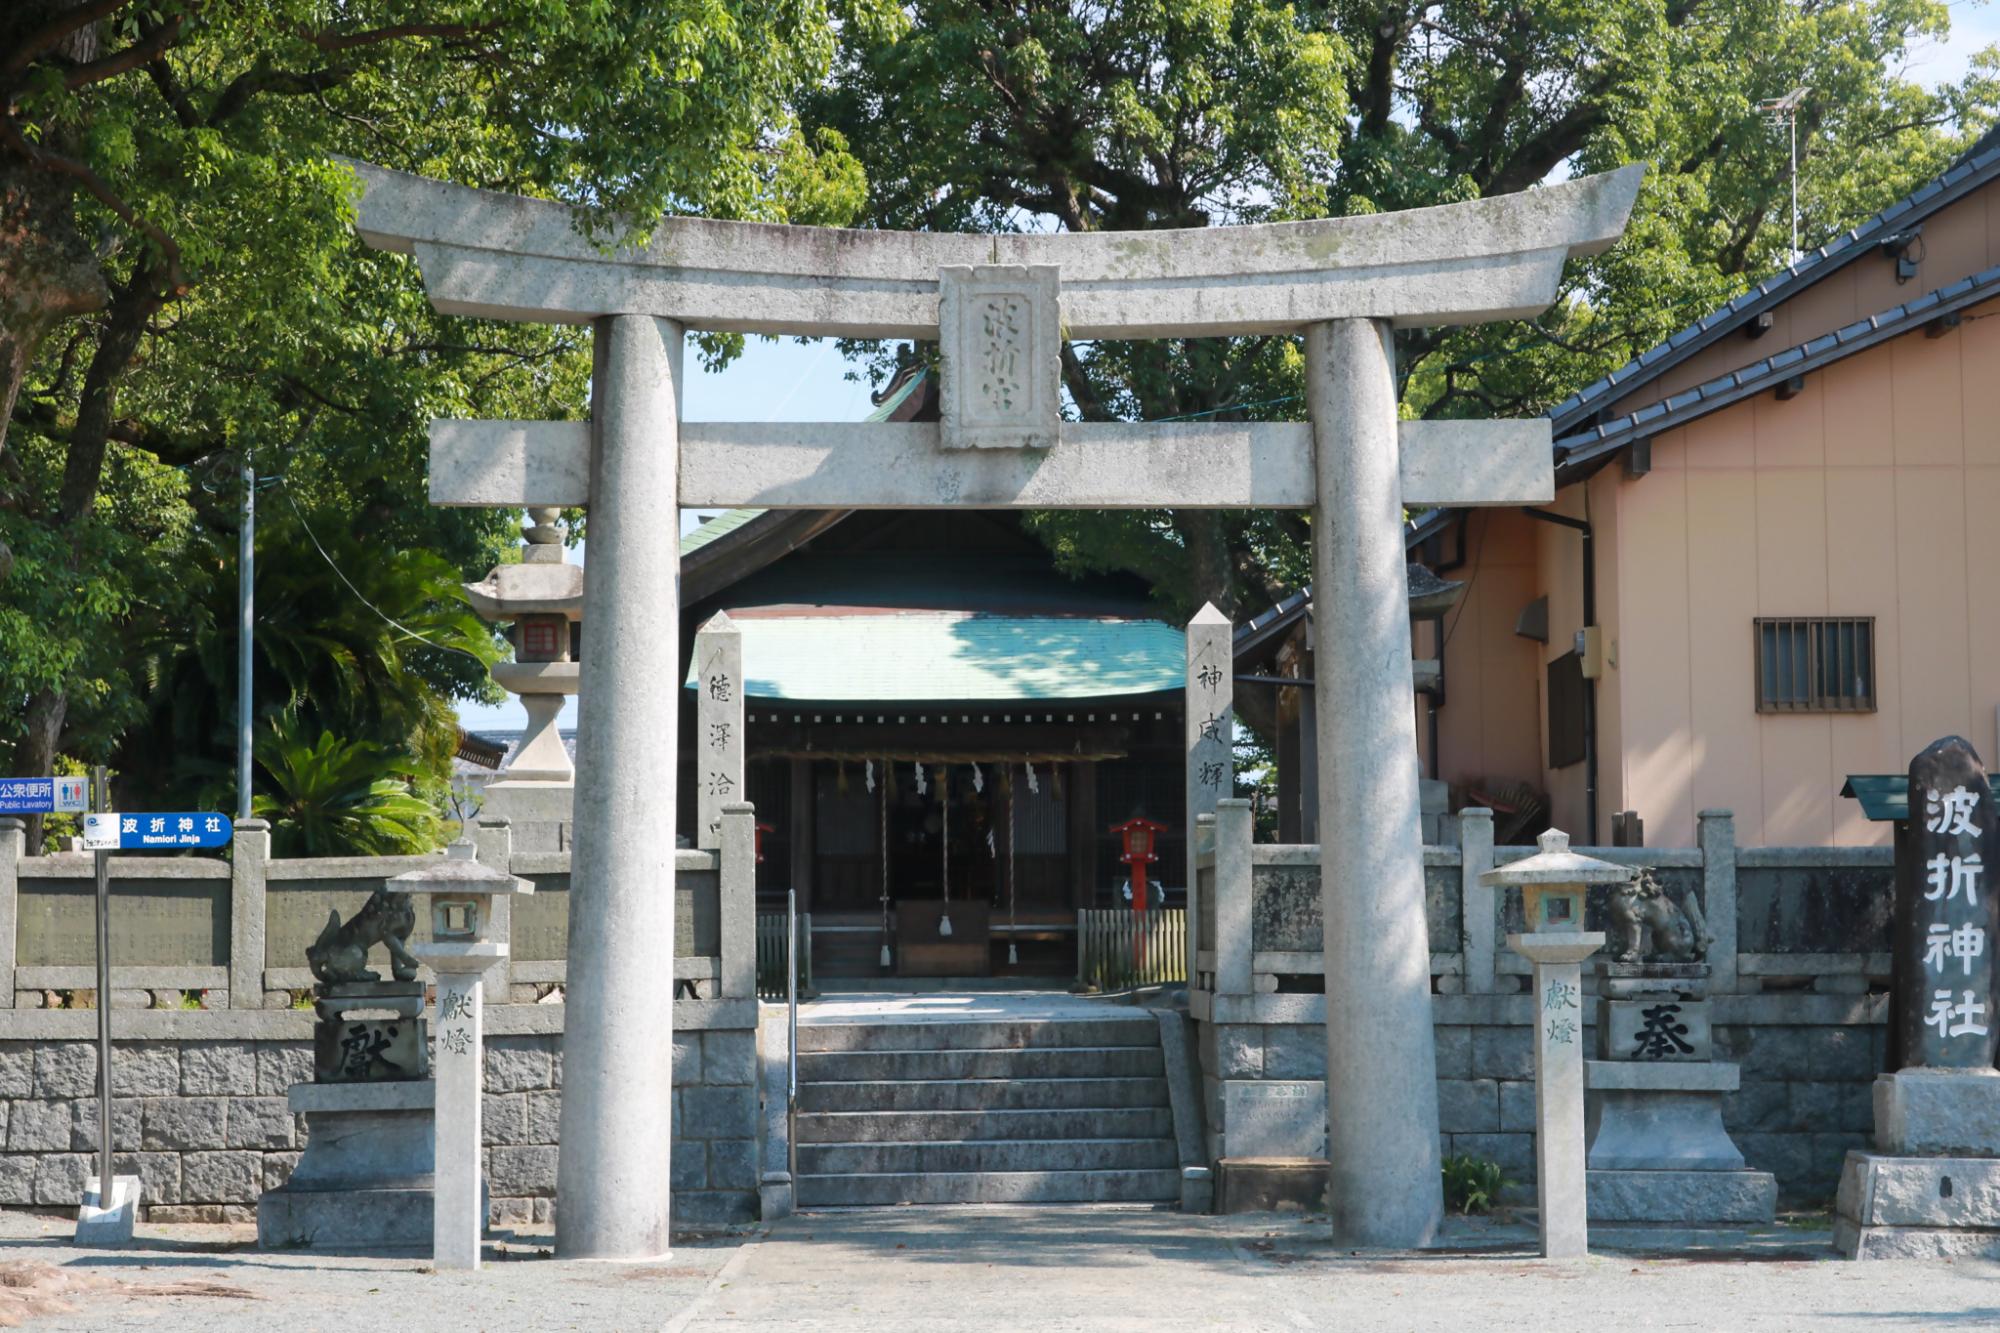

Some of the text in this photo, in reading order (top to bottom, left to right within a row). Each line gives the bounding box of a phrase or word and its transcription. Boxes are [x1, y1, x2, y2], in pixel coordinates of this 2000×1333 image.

[0, 783, 52, 798] 公衆便所
[0, 801, 53, 810] Public Lavatory
[122, 817, 221, 833] 波折神社
[143, 834, 201, 845] Namiori Jinja
[1924, 786, 1988, 1038] 波折神社
[1631, 1004, 1695, 1058] 奉
